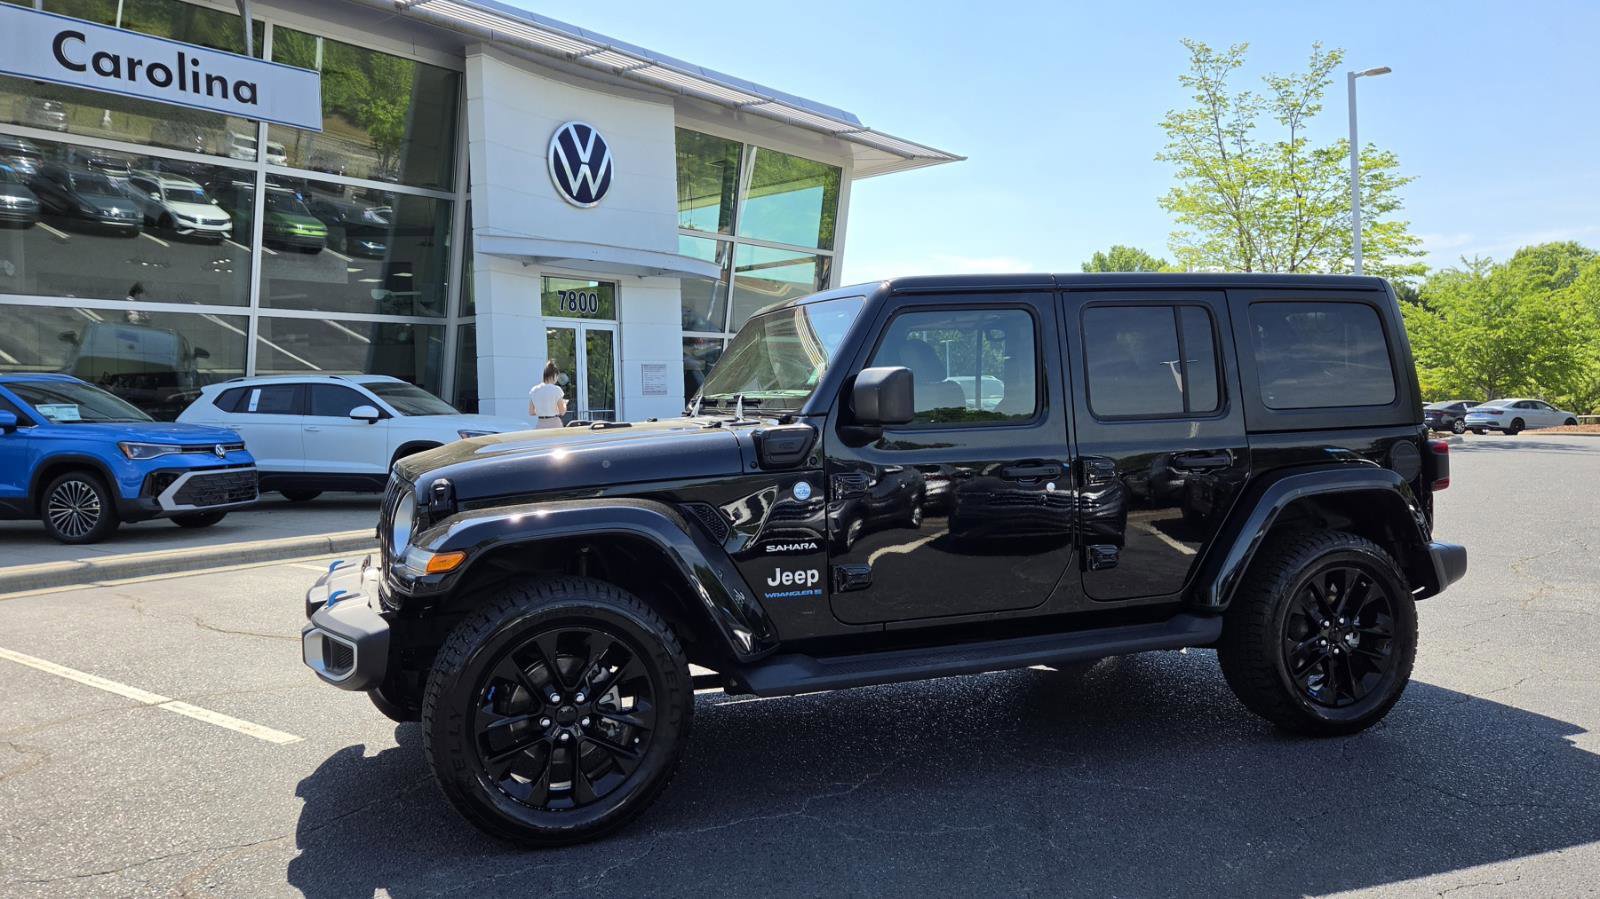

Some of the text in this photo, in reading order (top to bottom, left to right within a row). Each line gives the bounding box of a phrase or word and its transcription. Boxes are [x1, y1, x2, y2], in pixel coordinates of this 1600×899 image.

[52, 30, 258, 105] Carolina
[557, 289, 599, 313] 7800
[765, 542, 818, 552] SAHARA
[767, 567, 819, 587] Jeep
[764, 589, 814, 599] WRANGLER
